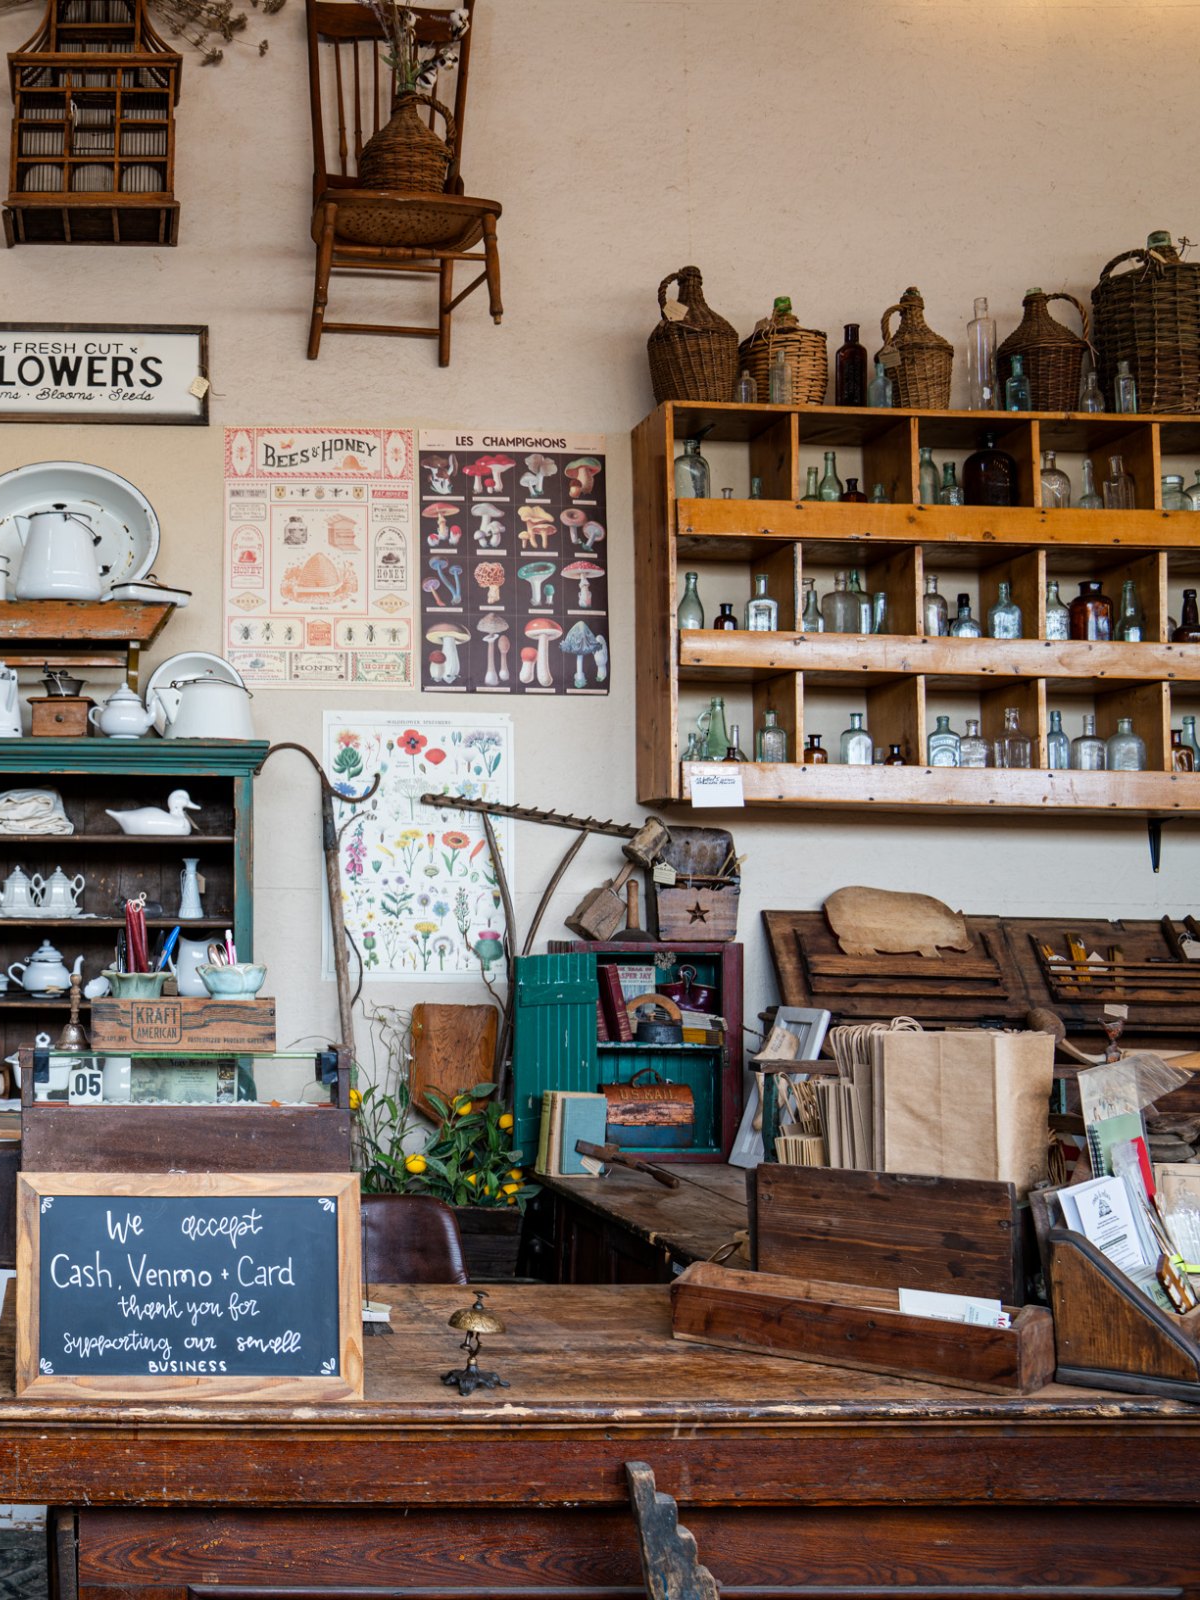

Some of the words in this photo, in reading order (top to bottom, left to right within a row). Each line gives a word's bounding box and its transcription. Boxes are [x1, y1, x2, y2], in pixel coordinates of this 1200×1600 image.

[13, 343, 76, 355] FRESH
[85, 343, 124, 355] CUT
[36, 387, 95, 401] Blooms
[108, 388, 154, 401] Seeds
[455, 436, 474, 447] LES
[482, 436, 567, 449] CHAMPIGNONS
[262, 442, 310, 468] BEES
[312, 446, 320, 458] &
[321, 438, 377, 462] HONEY
[377, 569, 405, 579] HONEY
[294, 664, 342, 672] HONEY
[135, 1007, 178, 1025] KRAFT
[136, 1027, 177, 1040] AMERICAN
[70, 1073, 101, 1096] .05
[106, 1210, 145, 1244] We
[181, 1208, 264, 1249] accept
[50, 1250, 123, 1291] Cash,
[127, 1253, 212, 1288] Venmo
[220, 1268, 230, 1281] +
[237, 1255, 296, 1288] Card
[118, 1294, 184, 1321] thank
[186, 1301, 224, 1327] you
[228, 1292, 260, 1321] for
[63, 1329, 172, 1360] supporting
[183, 1336, 217, 1350] our
[236, 1330, 301, 1354] small
[148, 1360, 227, 1374] BUSINESS
